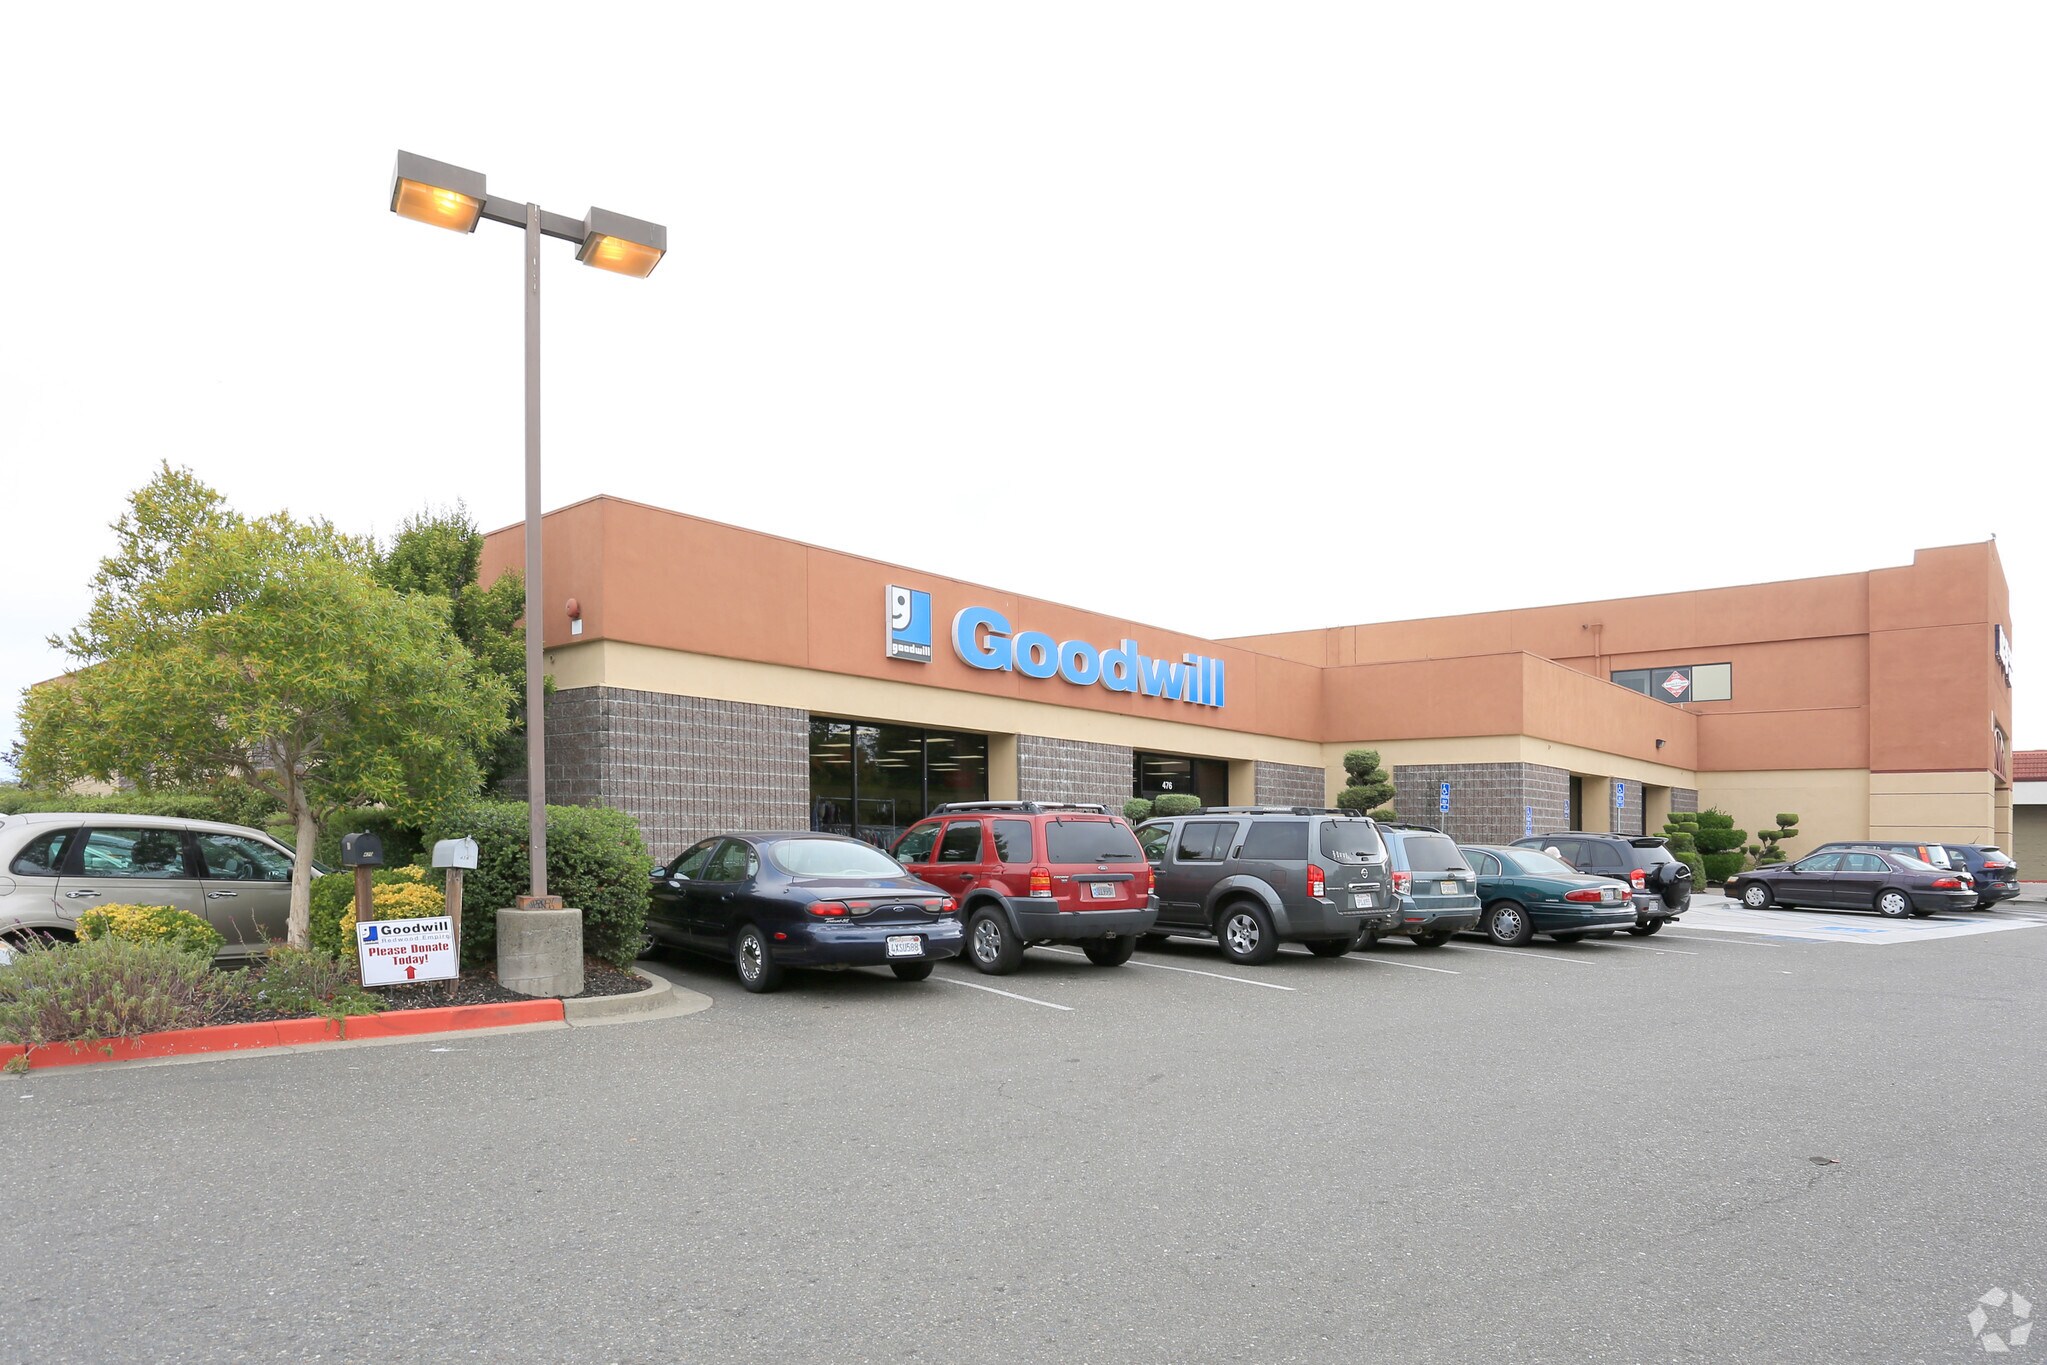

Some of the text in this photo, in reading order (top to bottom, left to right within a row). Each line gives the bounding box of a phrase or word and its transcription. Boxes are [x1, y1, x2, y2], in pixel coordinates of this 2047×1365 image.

[892, 643, 931, 657] goodwill
[951, 605, 1225, 708] Goodwill
[1161, 781, 1173, 790] 476
[381, 921, 448, 935] Goodwill
[368, 942, 449, 957] Please Donate
[392, 954, 429, 966] Today!
